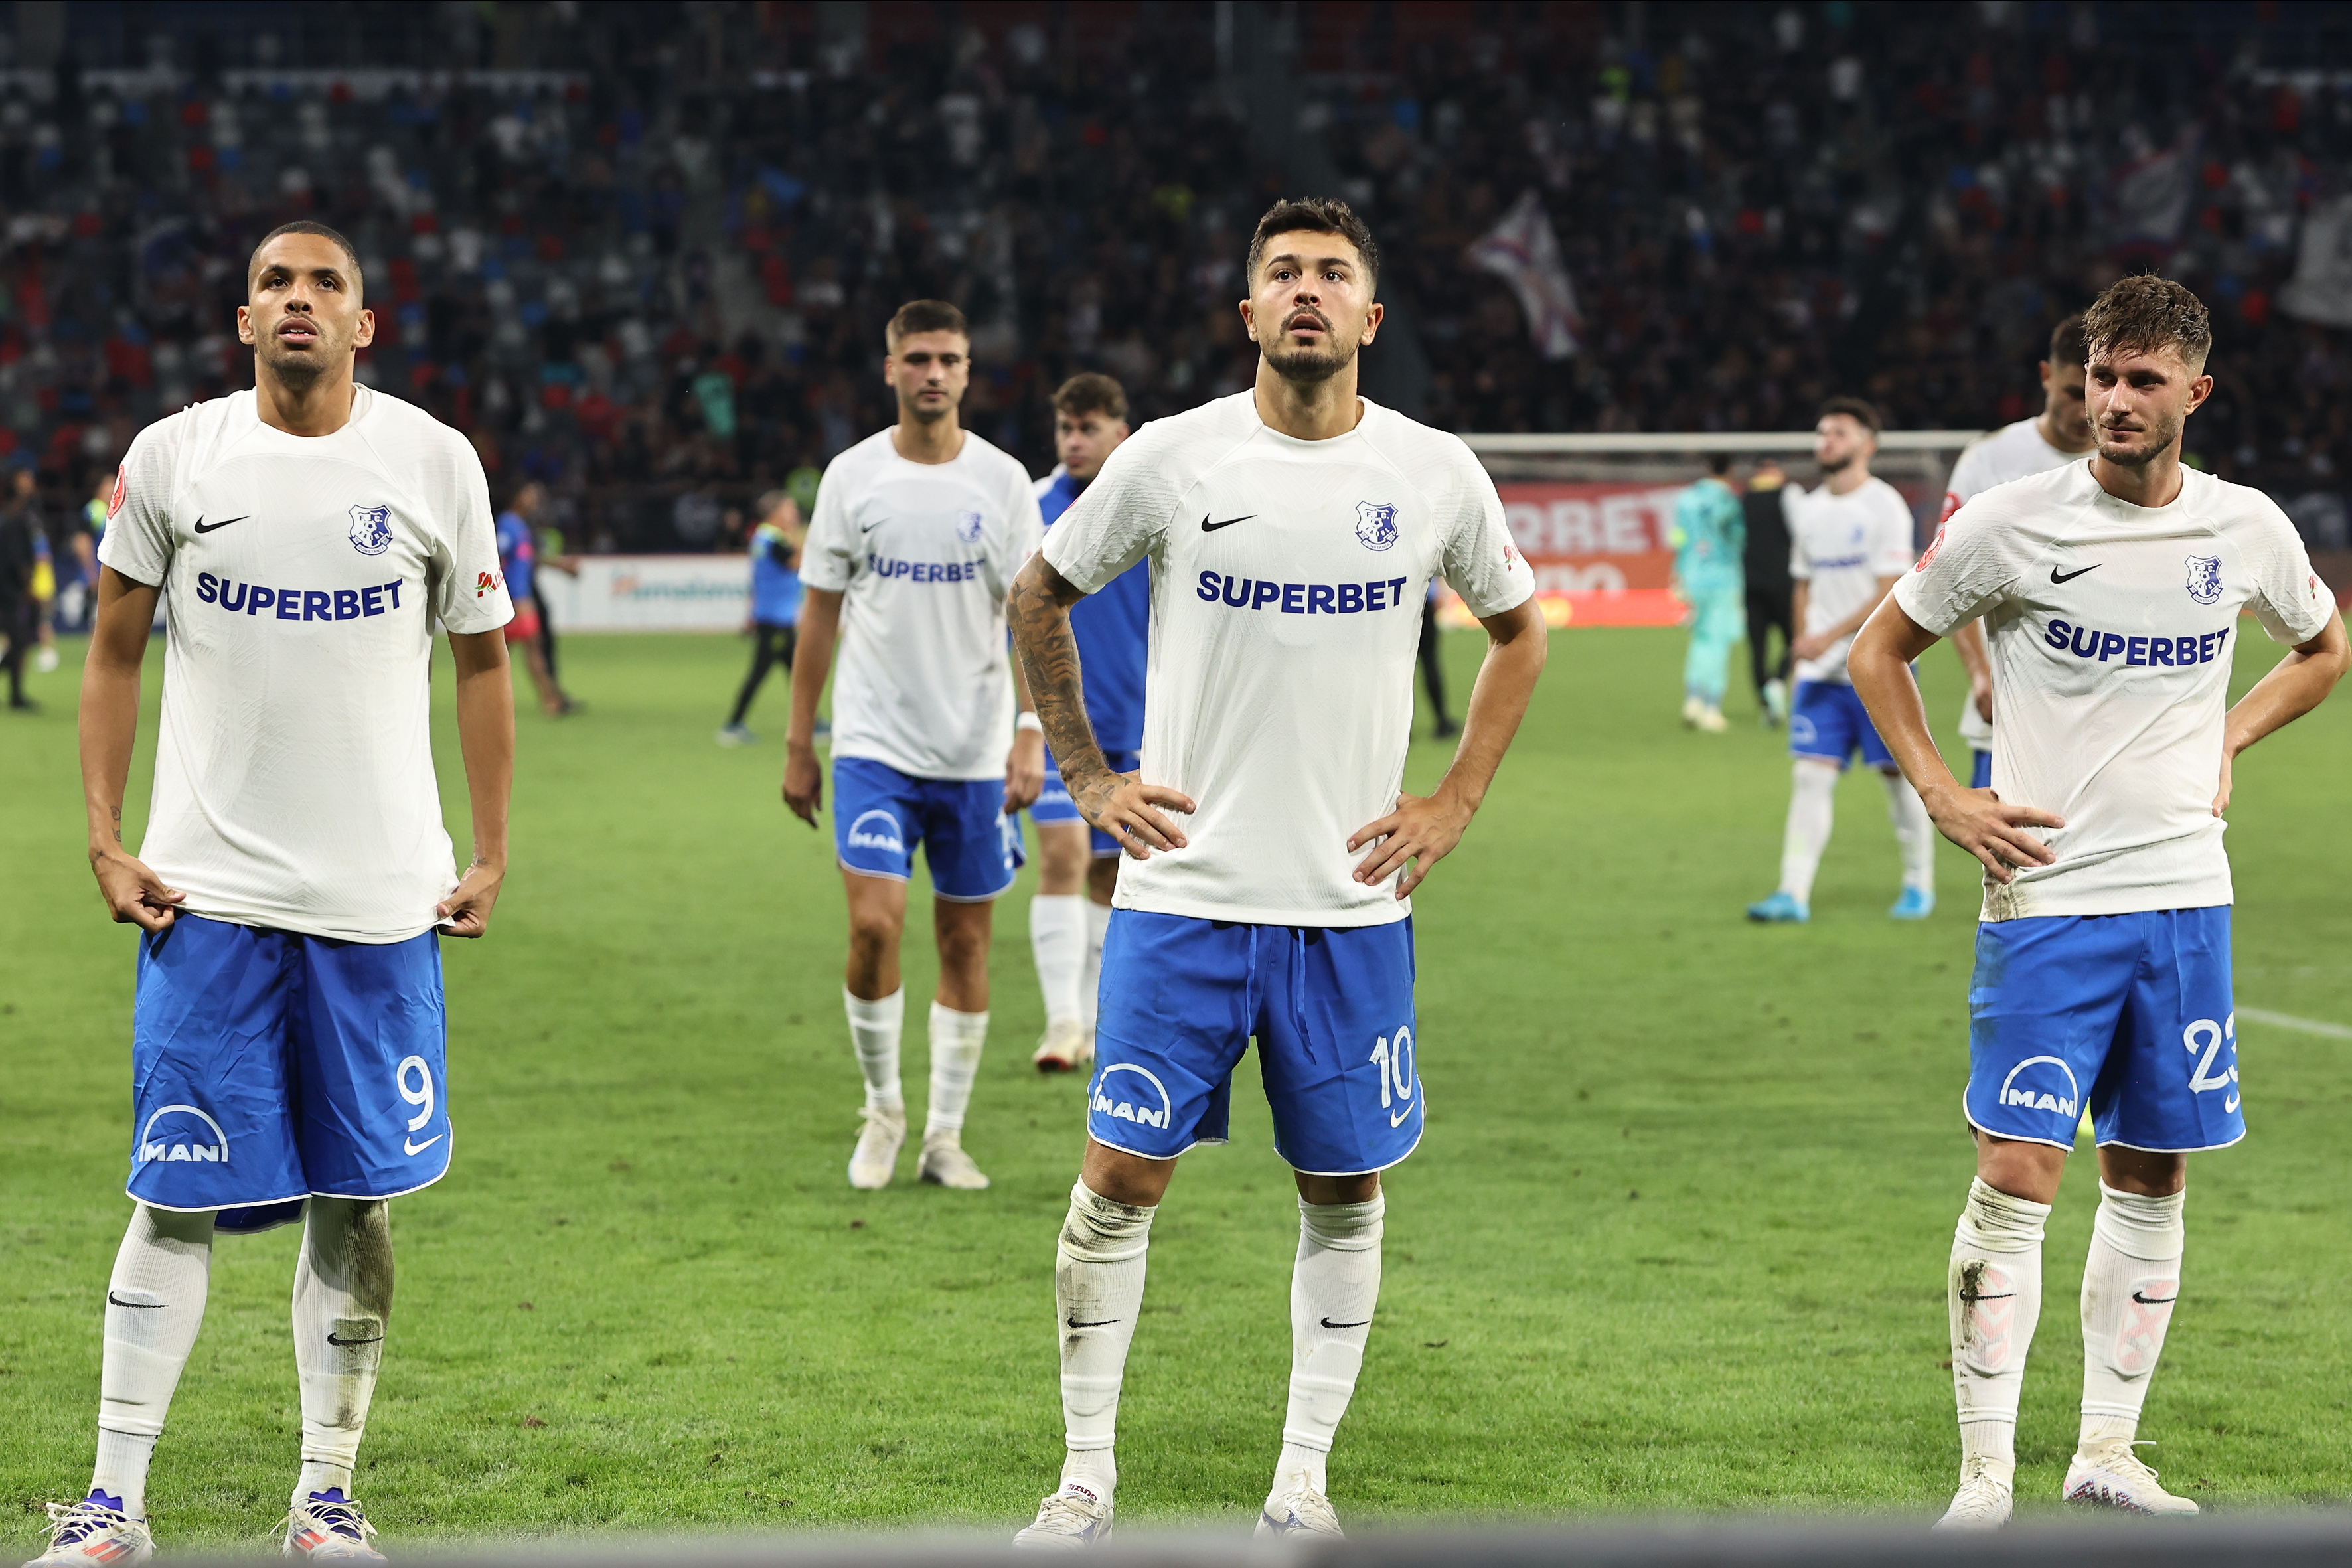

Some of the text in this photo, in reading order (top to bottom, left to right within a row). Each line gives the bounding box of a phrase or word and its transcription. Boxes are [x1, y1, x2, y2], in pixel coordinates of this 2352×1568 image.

[196, 572, 403, 621] SUPERBET
[1196, 570, 1407, 615] SUPERBET
[2044, 619, 2230, 666] SUPERBET
[1368, 1024, 1413, 1109] 10
[396, 1054, 434, 1133] 9
[1095, 1094, 1164, 1128] MAN
[2008, 1088, 2075, 1118] MAN
[144, 1144, 219, 1162] MAN
